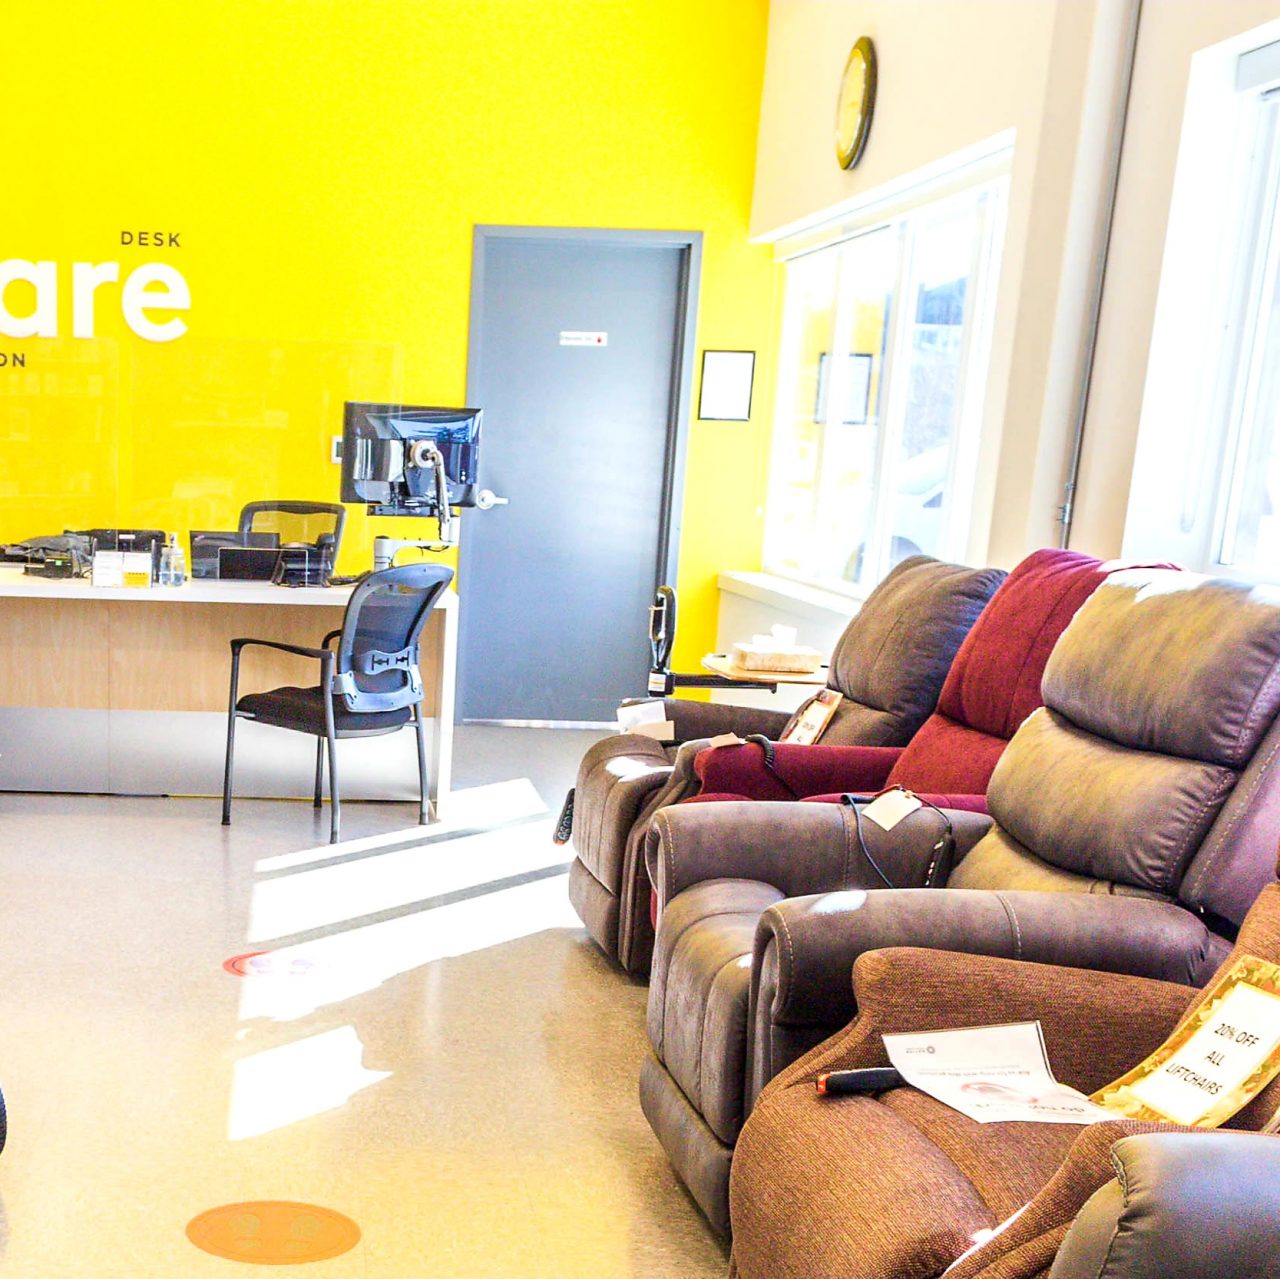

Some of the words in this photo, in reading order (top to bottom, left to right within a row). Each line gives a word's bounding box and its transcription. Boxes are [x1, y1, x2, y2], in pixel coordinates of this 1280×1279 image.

[120, 231, 181, 247] DESK
[1214, 1023, 1237, 1040] 20%
[1235, 1031, 1260, 1048] OFF
[1204, 1050, 1225, 1067] ALL
[1165, 1062, 1223, 1096] LIFTCHAIRS
